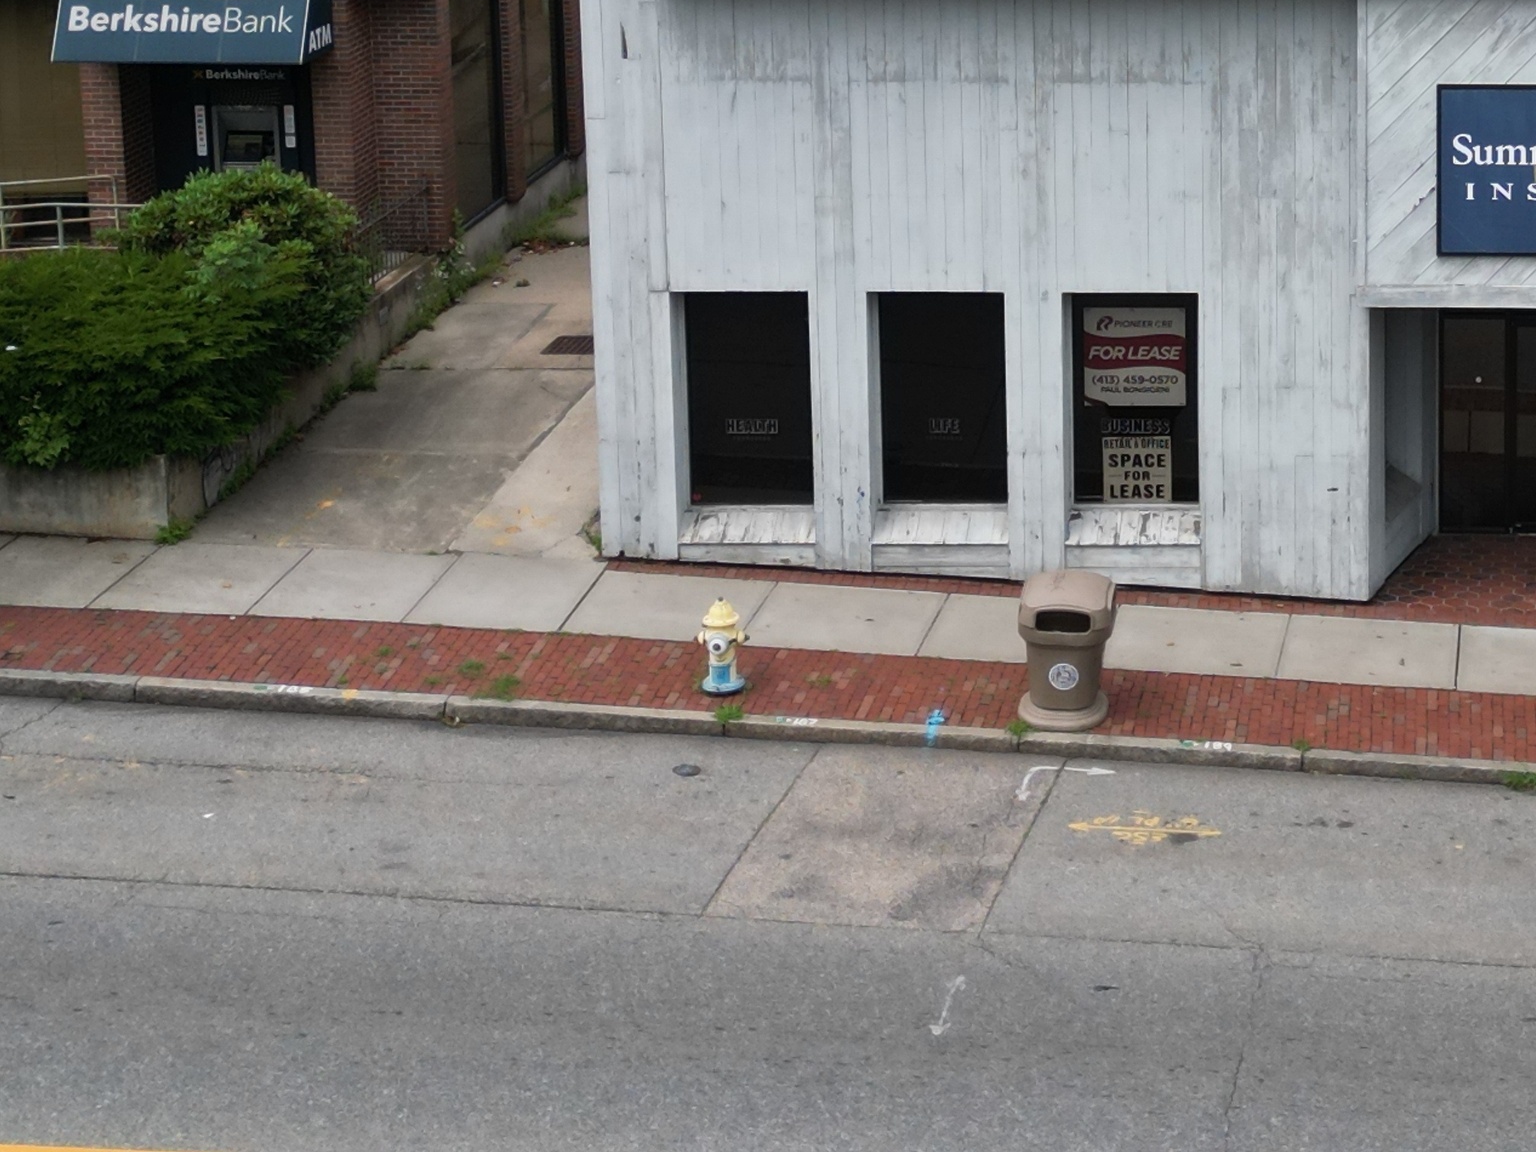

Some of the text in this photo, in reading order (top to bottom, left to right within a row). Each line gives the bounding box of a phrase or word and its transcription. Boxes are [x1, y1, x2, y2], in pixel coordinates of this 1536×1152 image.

[68, 5, 292, 33] BerkshireBank
[308, 23, 332, 54] ATM
[205, 68, 285, 80] BerkshireBank
[1114, 320, 1153, 329] PIONEER
[1088, 346, 1182, 360] FOR LEASE
[1092, 375, 1178, 385] (413) 459-0570
[725, 418, 778, 434] HEALTH
[928, 418, 960, 434] LIFE
[1101, 418, 1171, 434] BUSINESS
[1104, 439, 1132, 449] RETAIL
[1141, 439, 1169, 449] OFFICE
[1108, 453, 1166, 468] SPACE
[1124, 471, 1150, 481] FOR
[1110, 484, 1165, 499] LEASE
